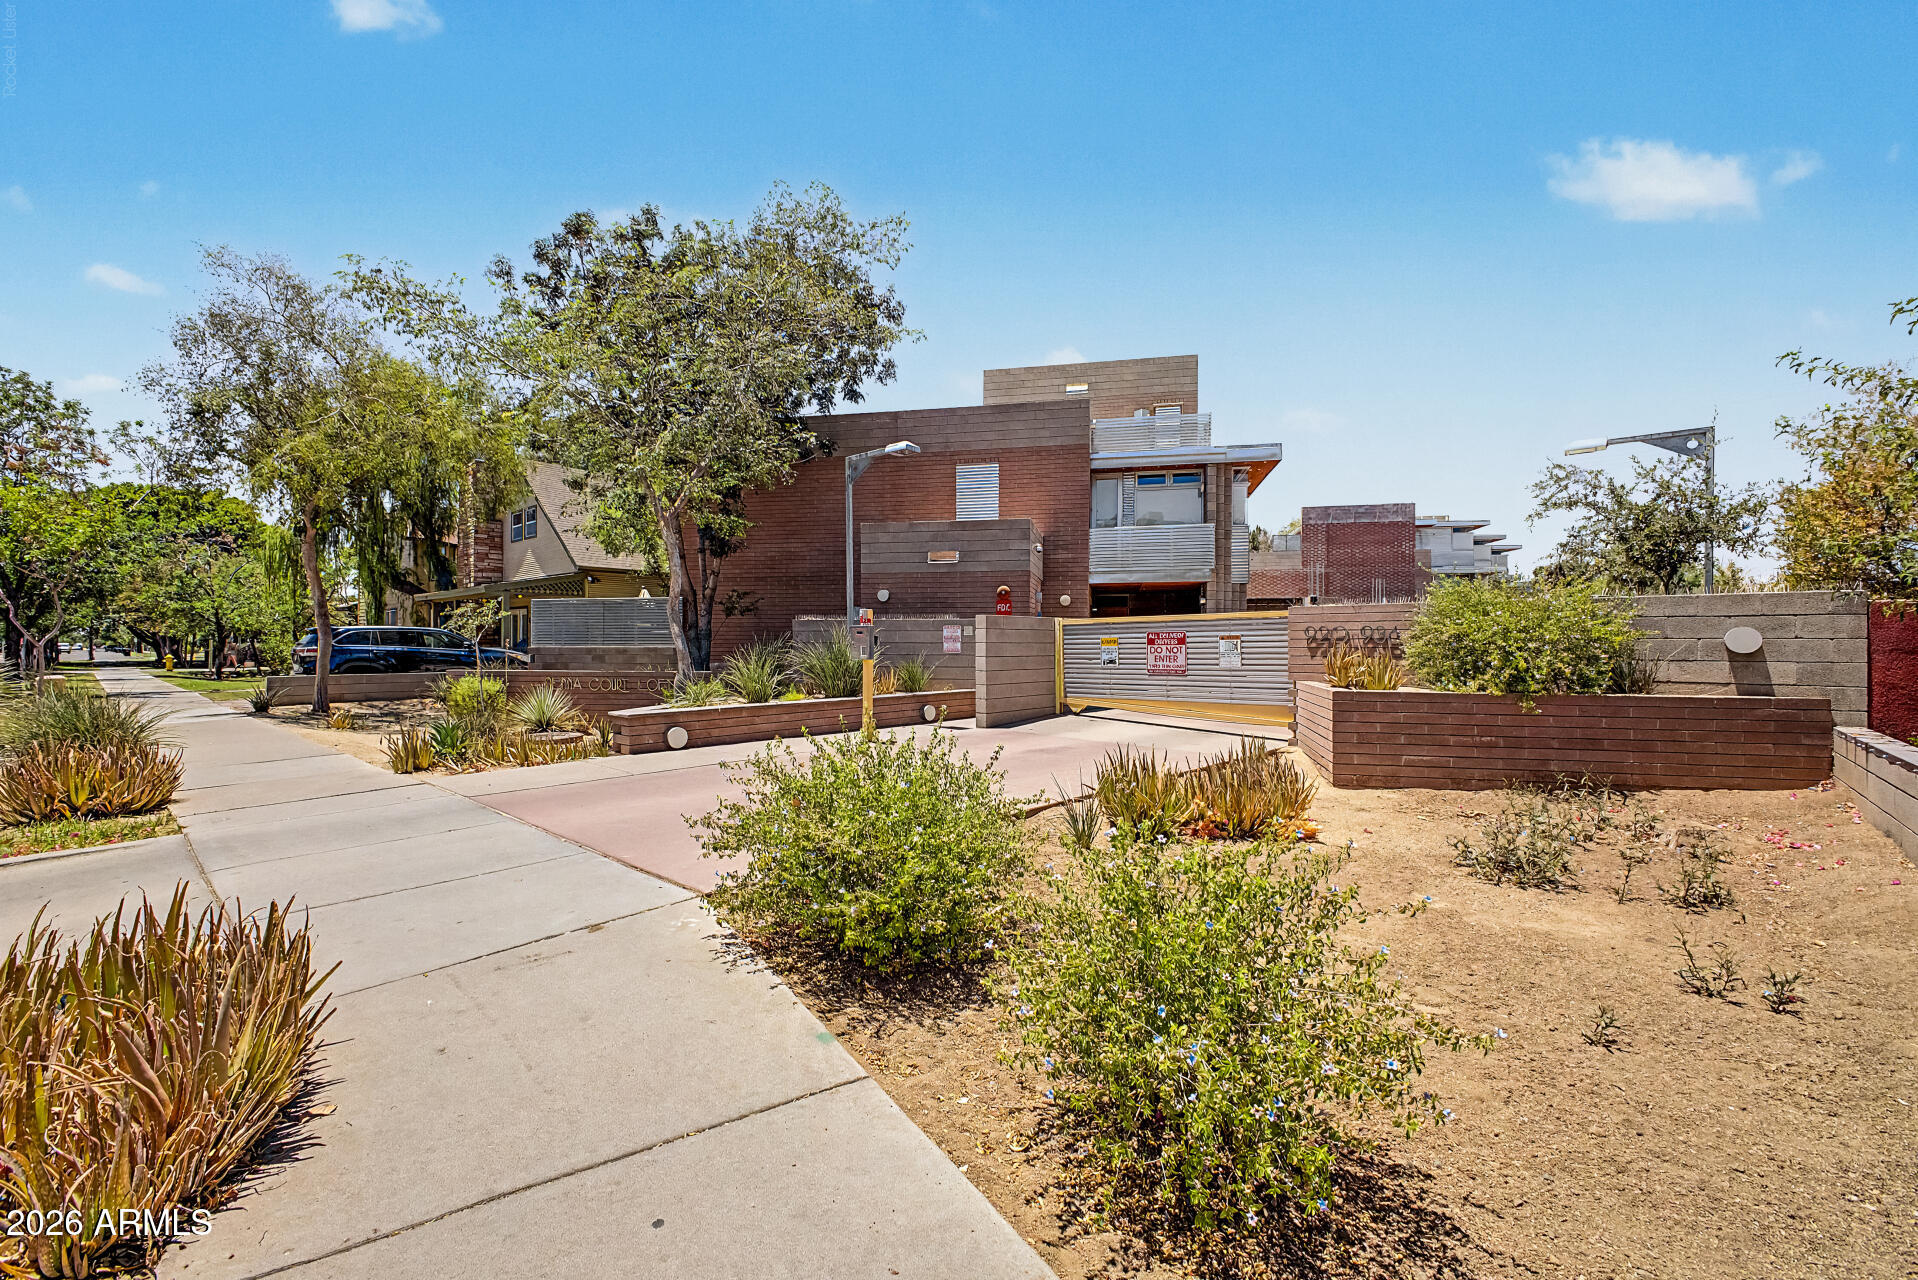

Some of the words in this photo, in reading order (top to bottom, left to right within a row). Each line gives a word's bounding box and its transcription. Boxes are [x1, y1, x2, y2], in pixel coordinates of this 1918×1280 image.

[997, 603, 1011, 612] FDC
[1149, 646, 1163, 654] DO
[1165, 646, 1184, 654] NOT
[1154, 655, 1179, 663] ENTER
[588, 678, 630, 693] COURT
